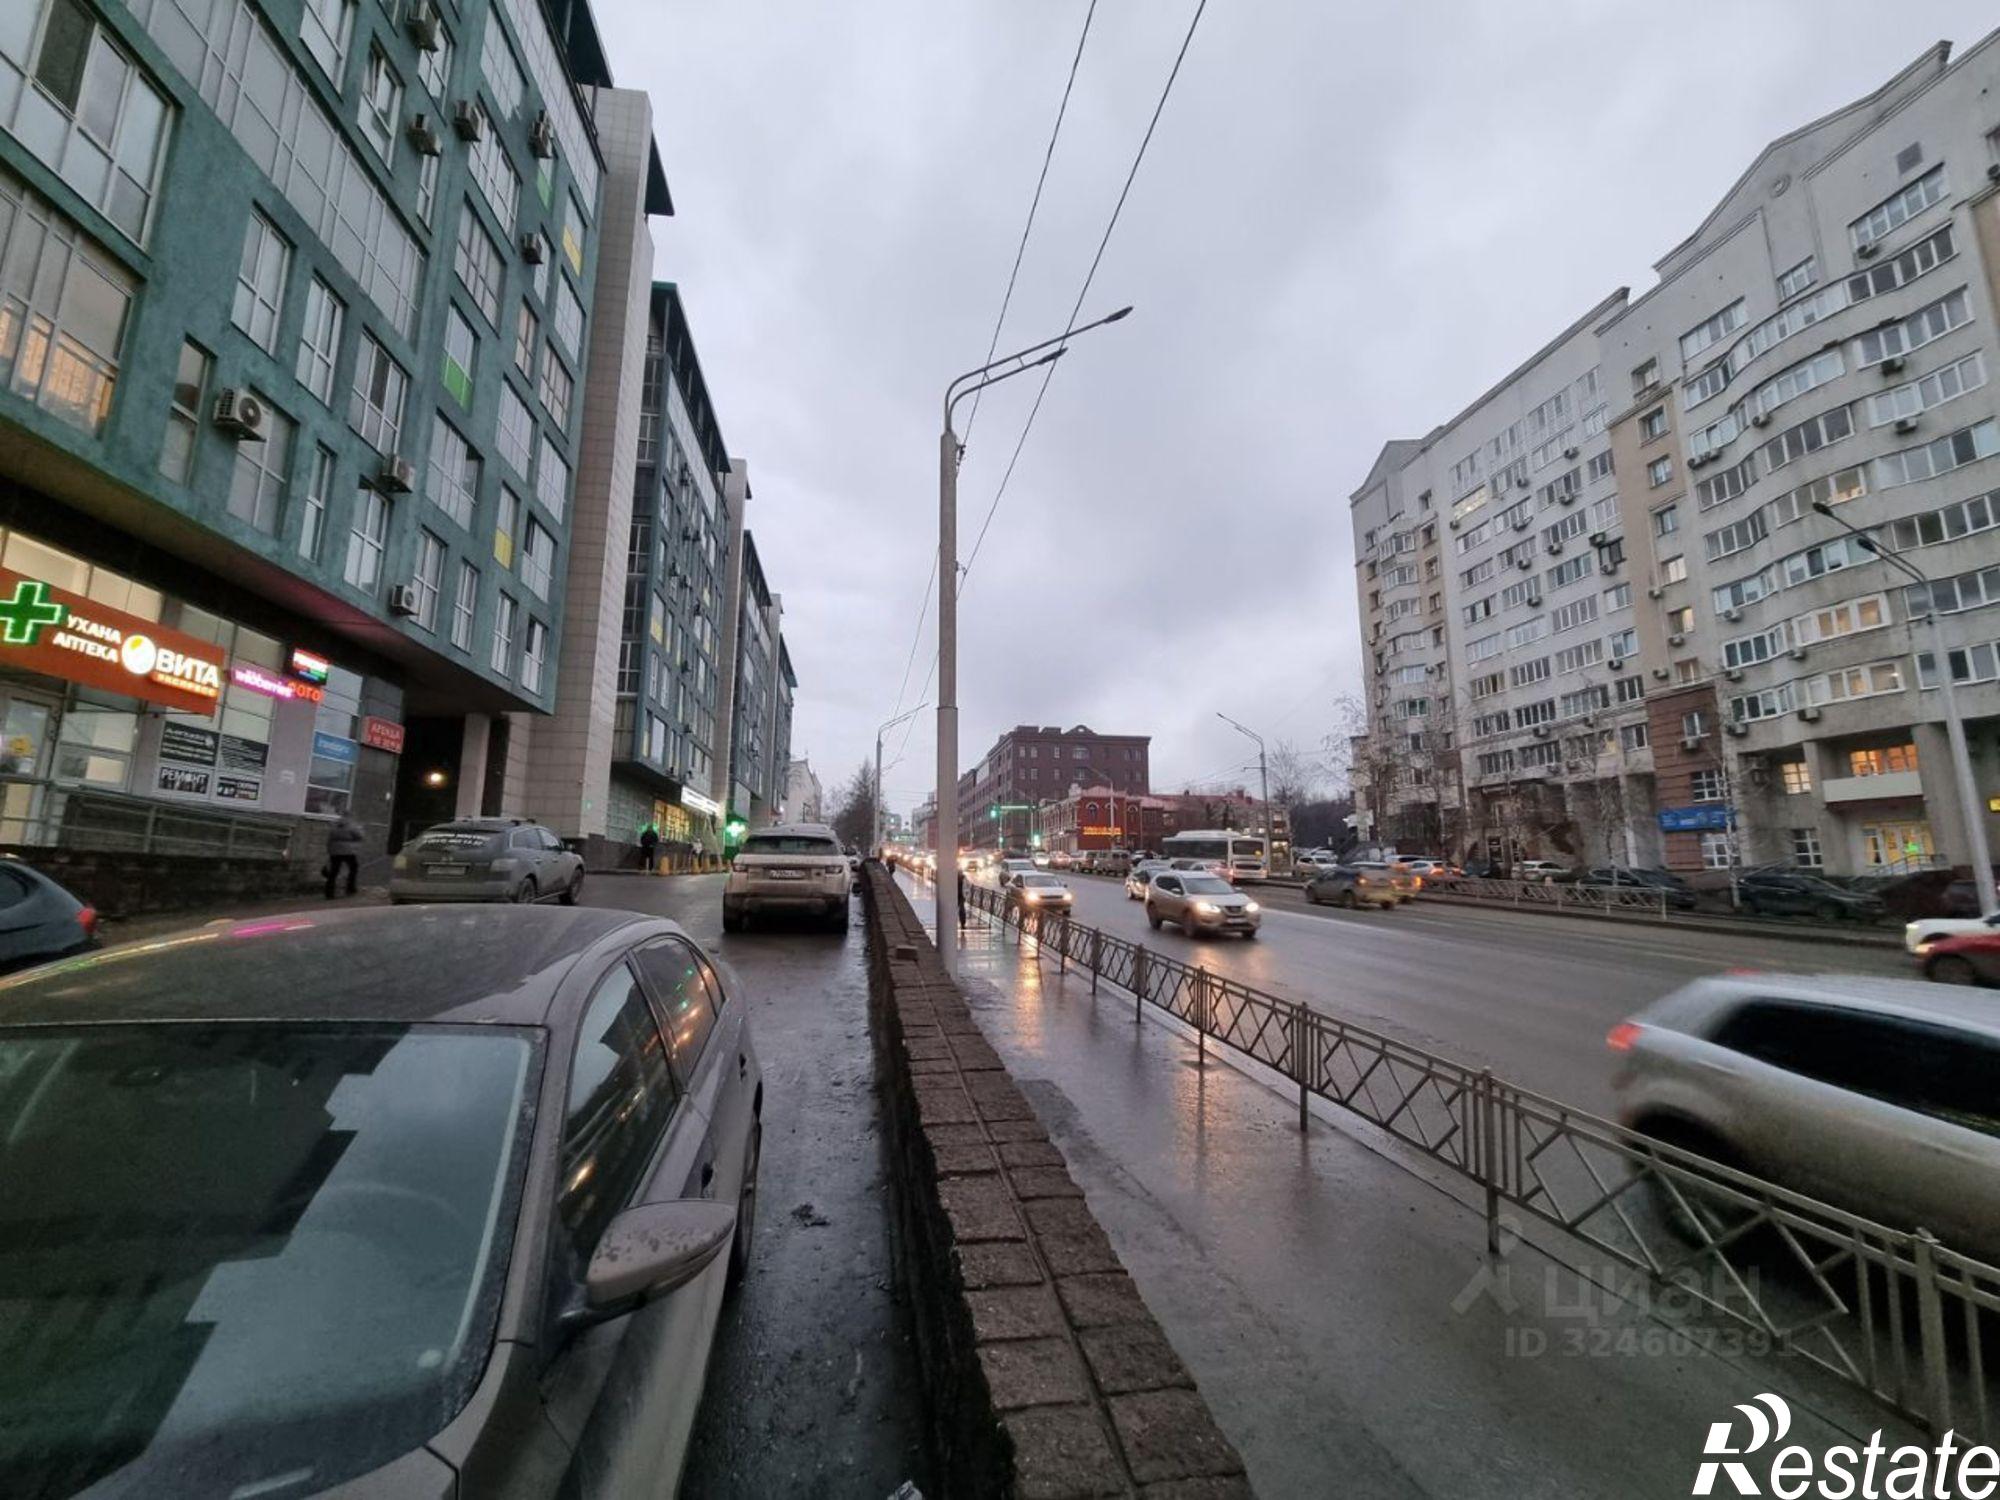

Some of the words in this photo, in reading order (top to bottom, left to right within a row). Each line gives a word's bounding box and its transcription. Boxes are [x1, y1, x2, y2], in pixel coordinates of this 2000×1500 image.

[52, 631, 119, 663] АПТЕКА
[155, 648, 219, 688] ВИТА
[161, 769, 207, 784] РЕМОНТ
